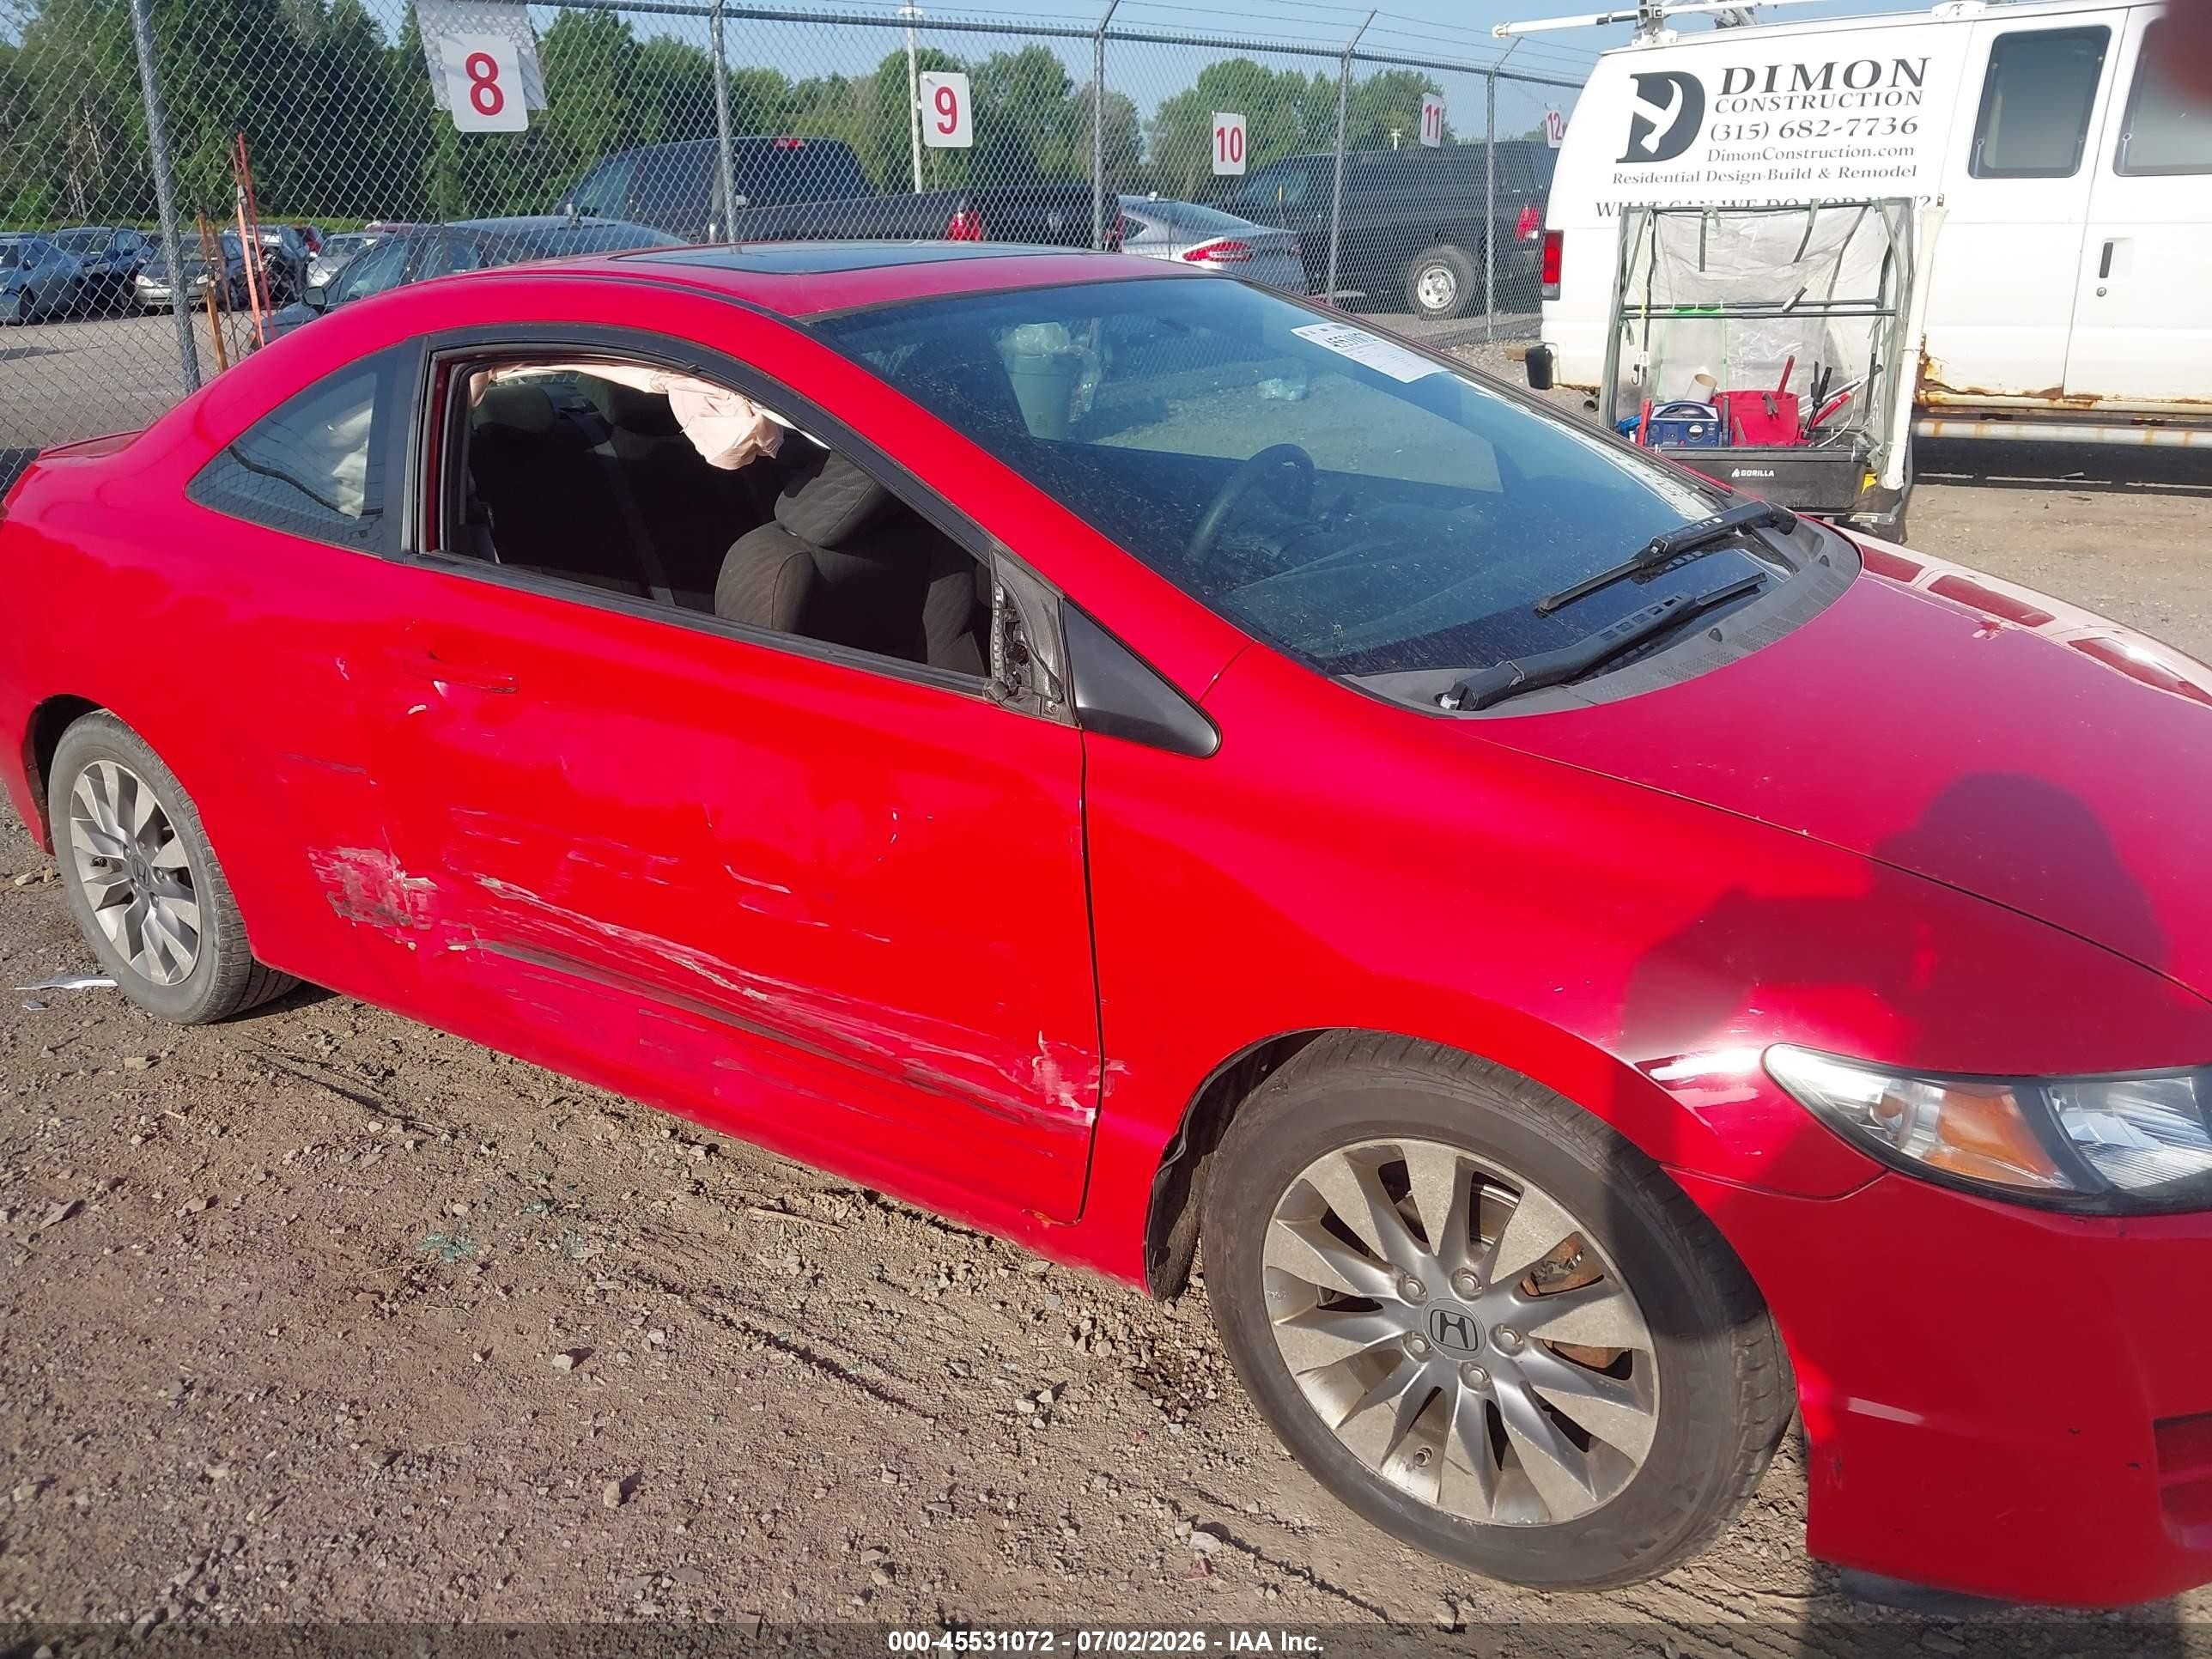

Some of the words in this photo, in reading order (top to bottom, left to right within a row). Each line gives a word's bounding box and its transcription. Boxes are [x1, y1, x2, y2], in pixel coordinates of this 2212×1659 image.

[465, 52, 505, 116] 8
[1717, 58, 1931, 95] DIMON
[935, 86, 957, 135] 9
[1715, 90, 1923, 113] CONSTRUCTION
[1425, 104, 1440, 139] 11
[1710, 121, 1770, 143] (315)
[1778, 116, 1919, 139] 682-7736
[1216, 126, 1243, 163] 10
[1706, 144, 1915, 162] DimonConstruction.com
[1613, 171, 1700, 185] Residential
[1818, 167, 1831, 179] &
[1838, 165, 1917, 179] Remodel
